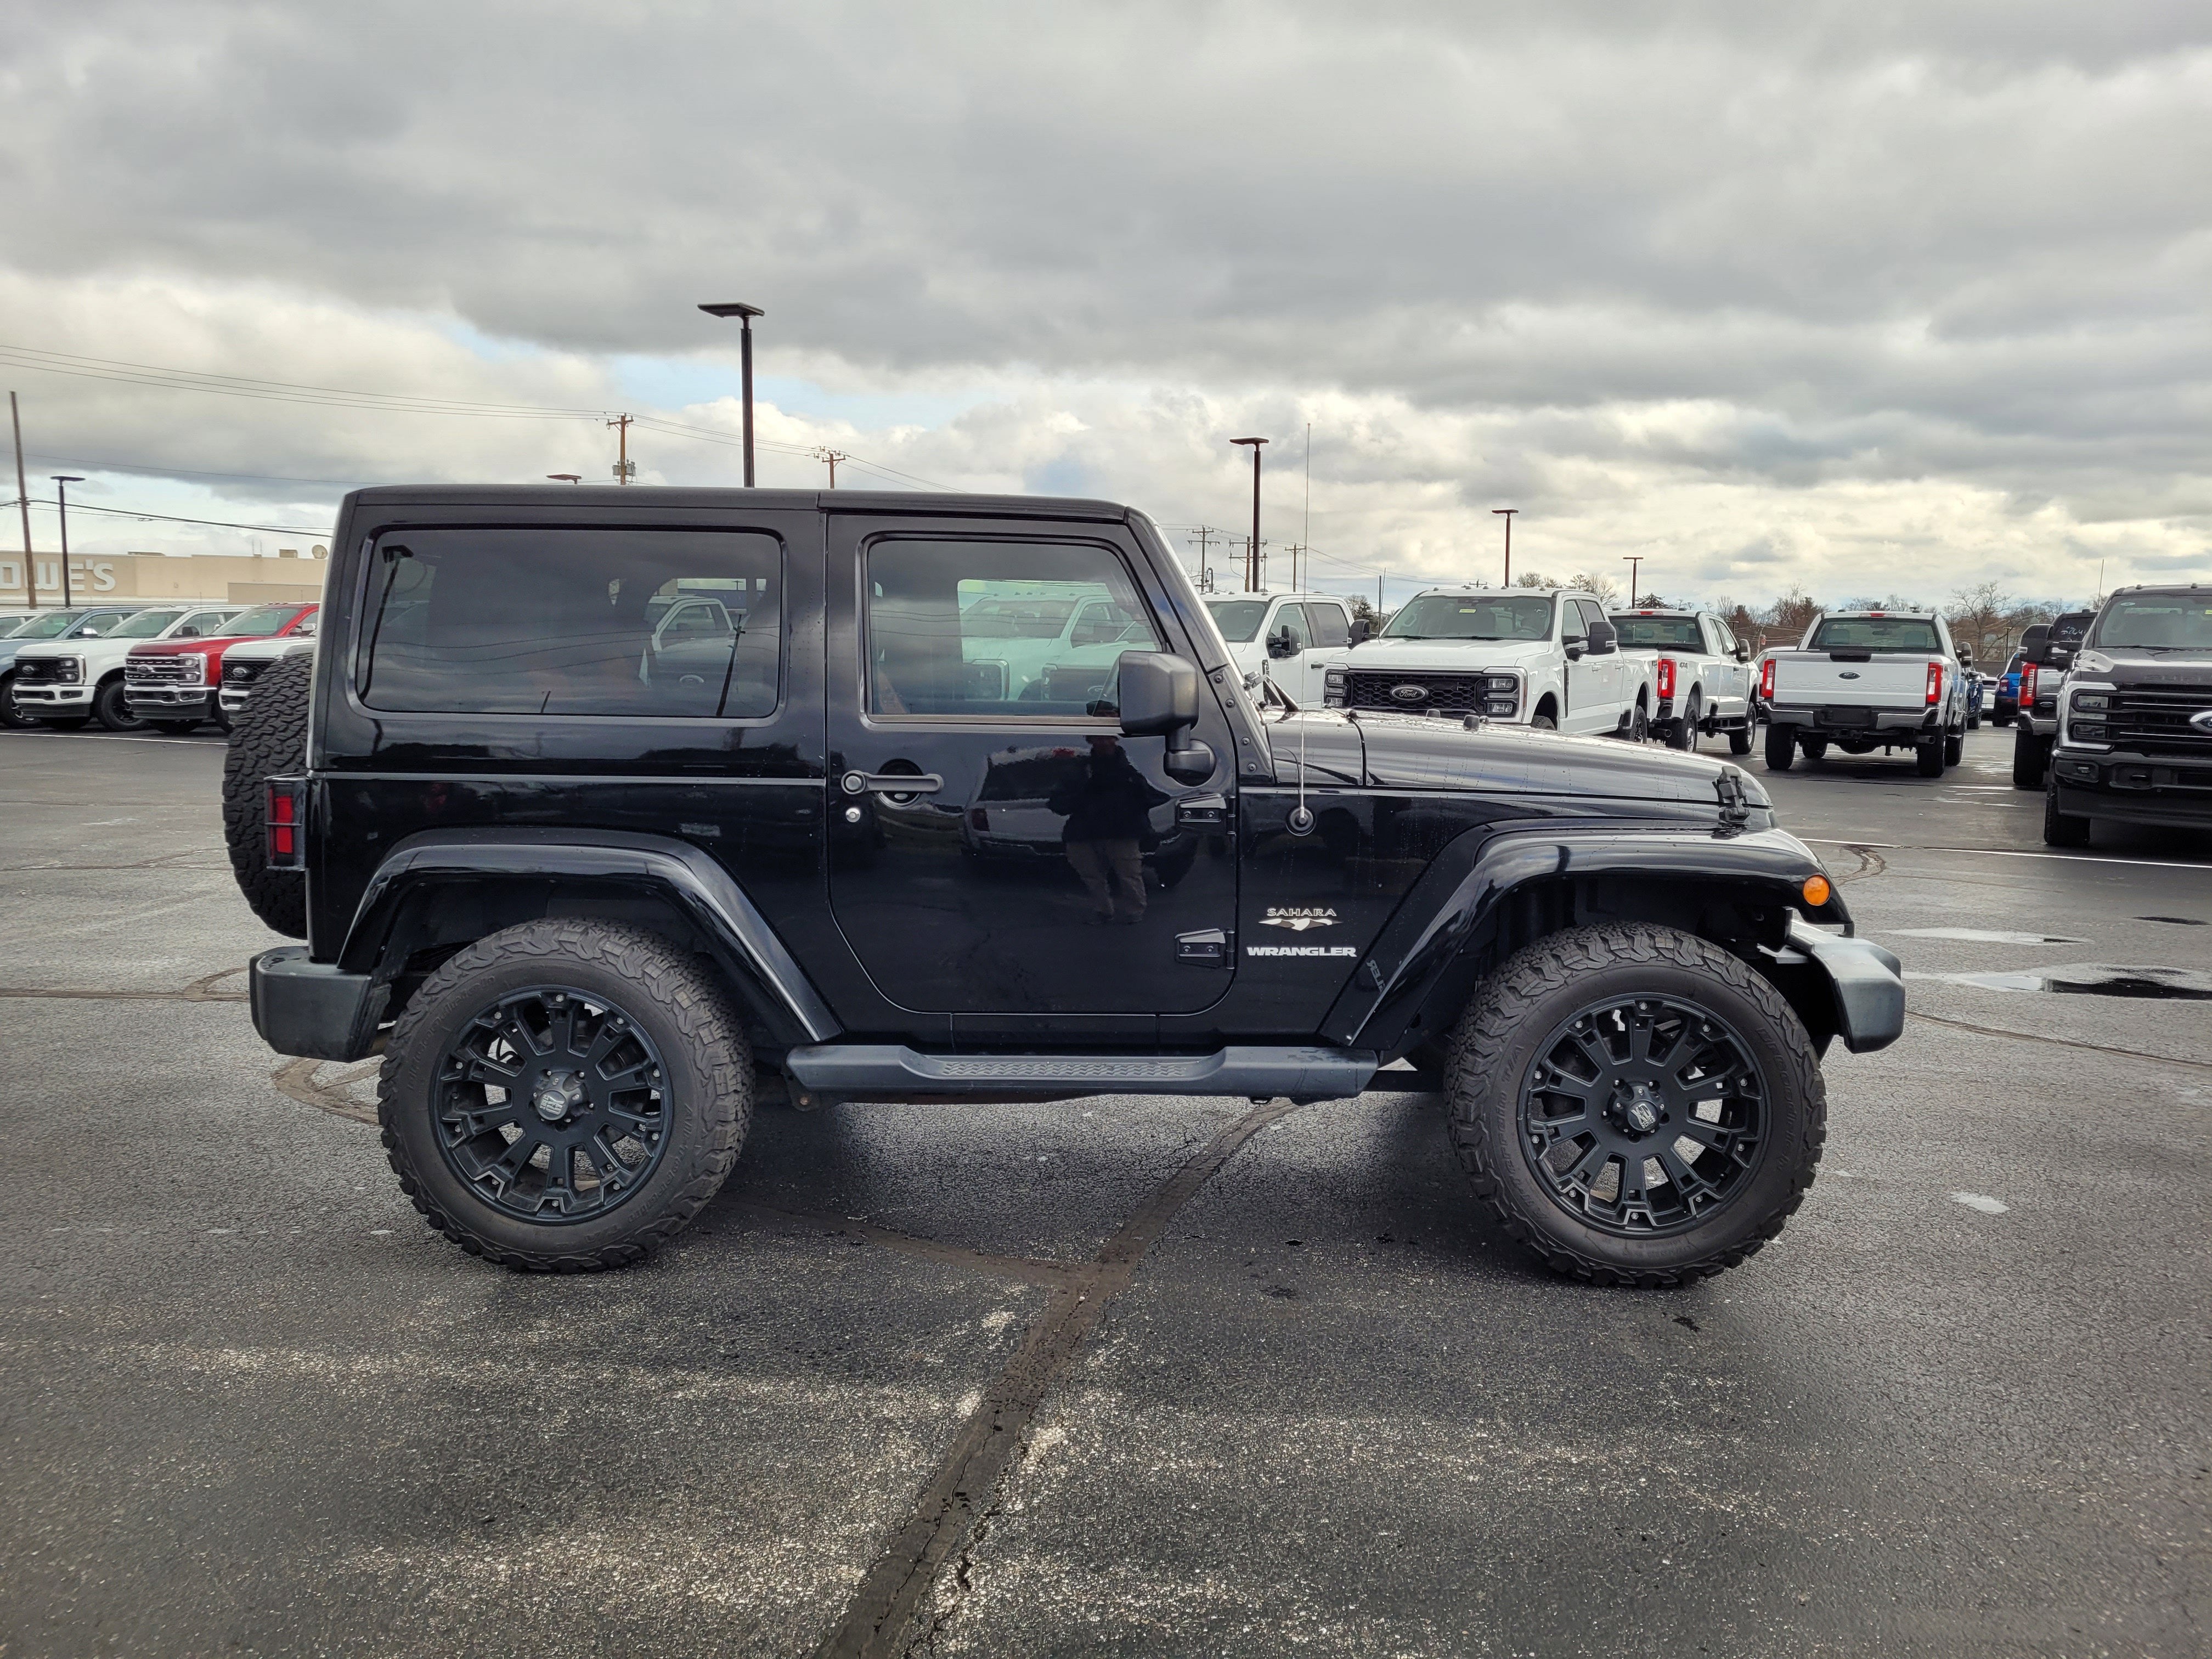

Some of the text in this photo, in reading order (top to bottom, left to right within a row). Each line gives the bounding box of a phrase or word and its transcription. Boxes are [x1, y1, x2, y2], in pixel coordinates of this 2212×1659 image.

[1400, 689, 1418, 698] Ford
[1267, 908, 1337, 917] SAHARA
[1246, 947, 1357, 957] WRANGLER
[1641, 1116, 1656, 1129] SERIES
